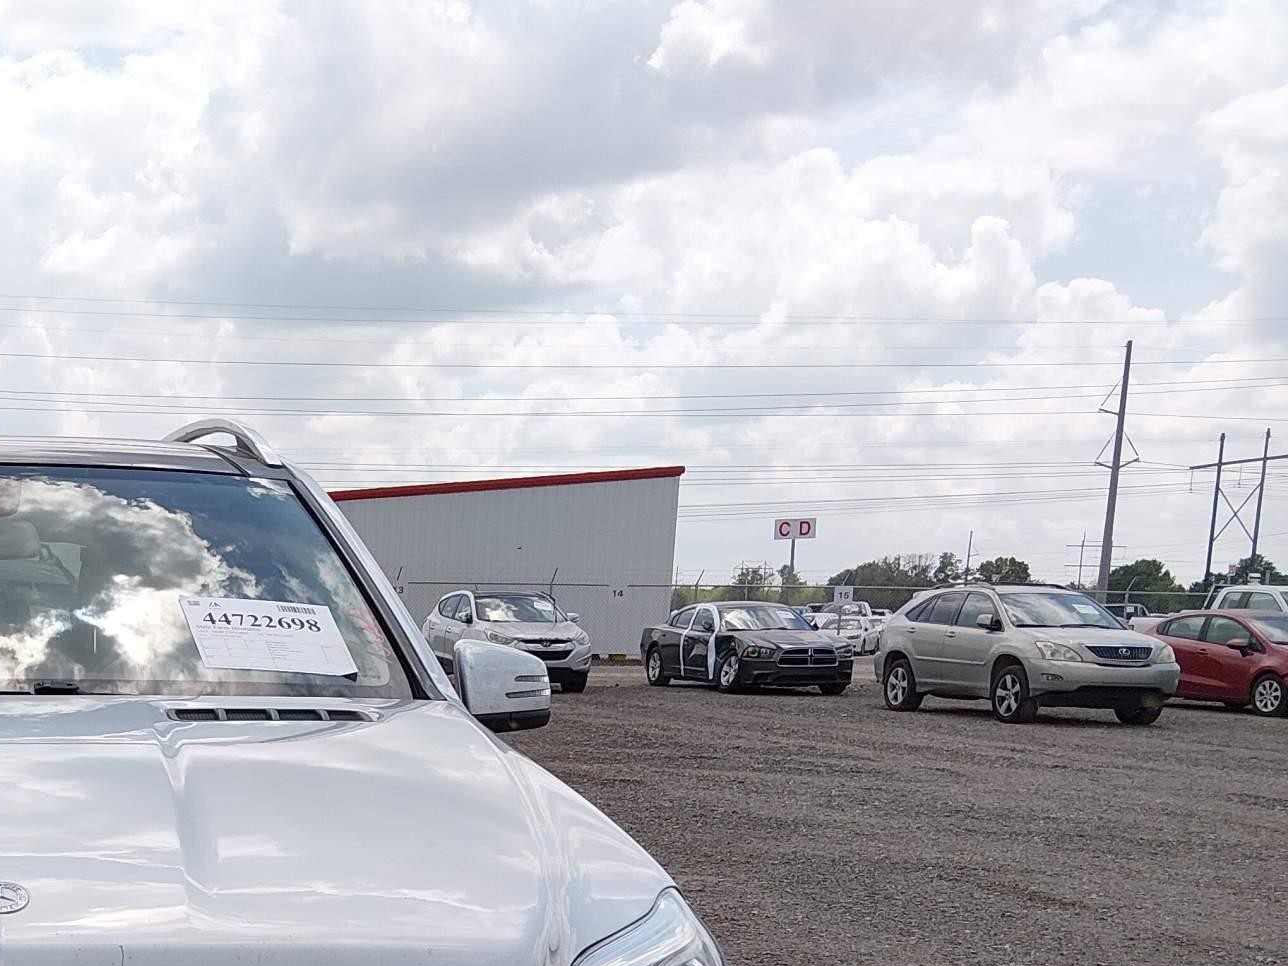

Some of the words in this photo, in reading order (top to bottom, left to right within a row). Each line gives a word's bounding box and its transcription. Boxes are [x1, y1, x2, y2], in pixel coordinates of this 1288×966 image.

[779, 521, 791, 537] C
[800, 521, 811, 536] D
[838, 591, 850, 599] 15
[202, 611, 322, 633] 44722698
